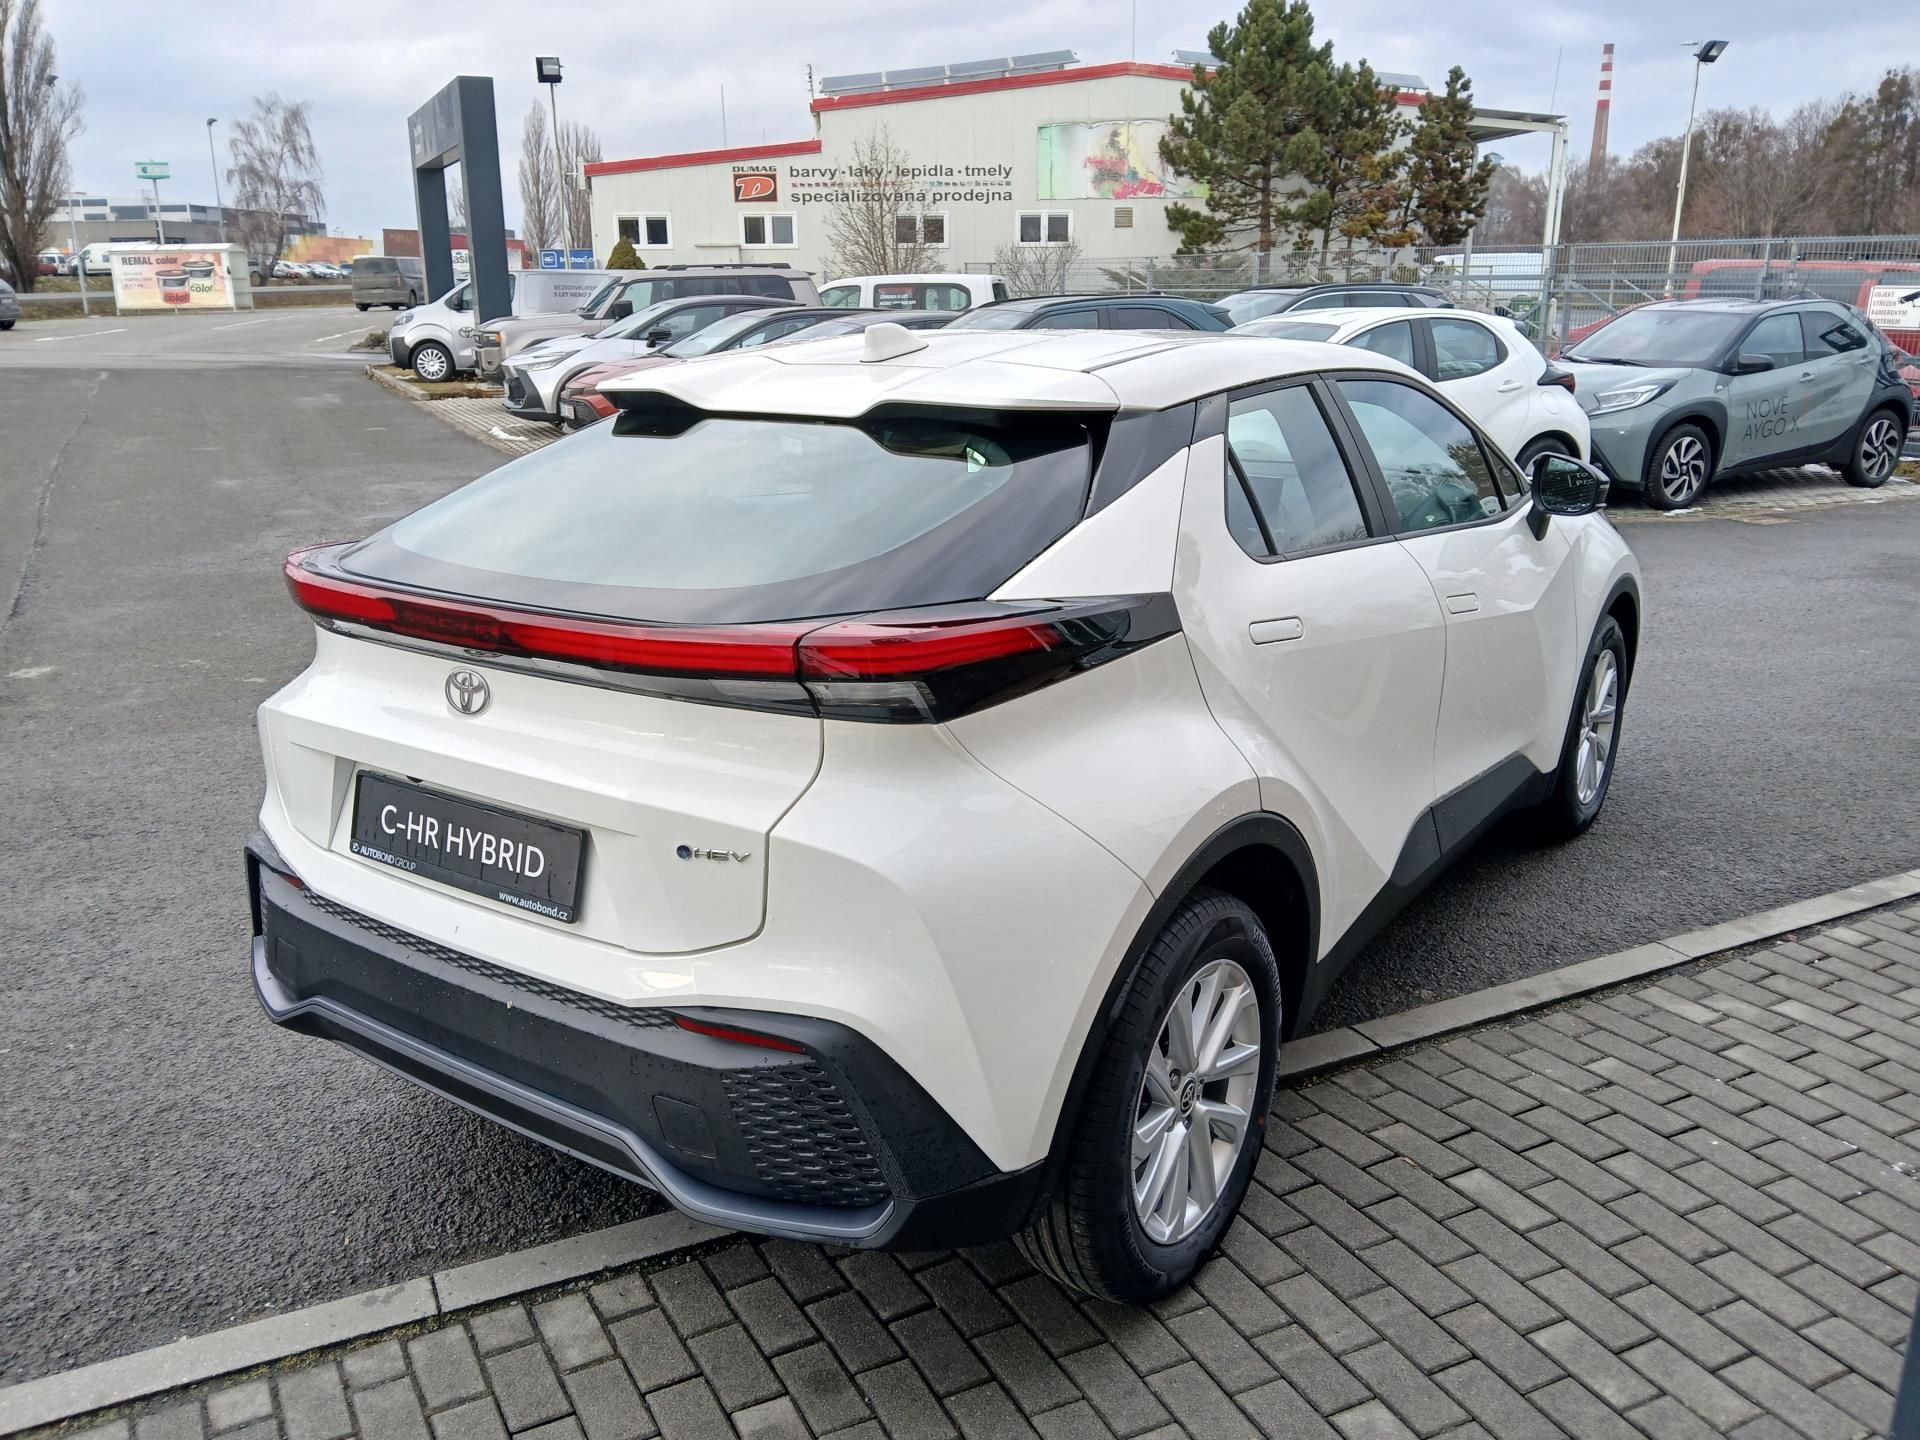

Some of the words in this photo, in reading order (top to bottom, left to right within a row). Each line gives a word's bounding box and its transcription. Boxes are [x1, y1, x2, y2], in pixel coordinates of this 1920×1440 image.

[732, 165, 777, 173] DUMAG
[789, 165, 838, 180] barvy
[849, 165, 884, 180] laky
[896, 164, 954, 180] lepidla
[964, 164, 1013, 179] tmely
[790, 189, 926, 206] specializovaná
[932, 188, 1013, 205] prodejna
[121, 257, 154, 266] REMAL
[155, 255, 178, 265] color
[190, 283, 214, 293] color
[1742, 417, 1786, 442] AYGO
[1790, 415, 1801, 433] X
[381, 804, 439, 850] C-HR
[446, 822, 545, 878] HYBRID
[359, 847, 395, 865] AUTOBOND
[395, 856, 416, 872] GROUP
[693, 846, 751, 863] HEV
[498, 890, 568, 921] www.autobond.cz
